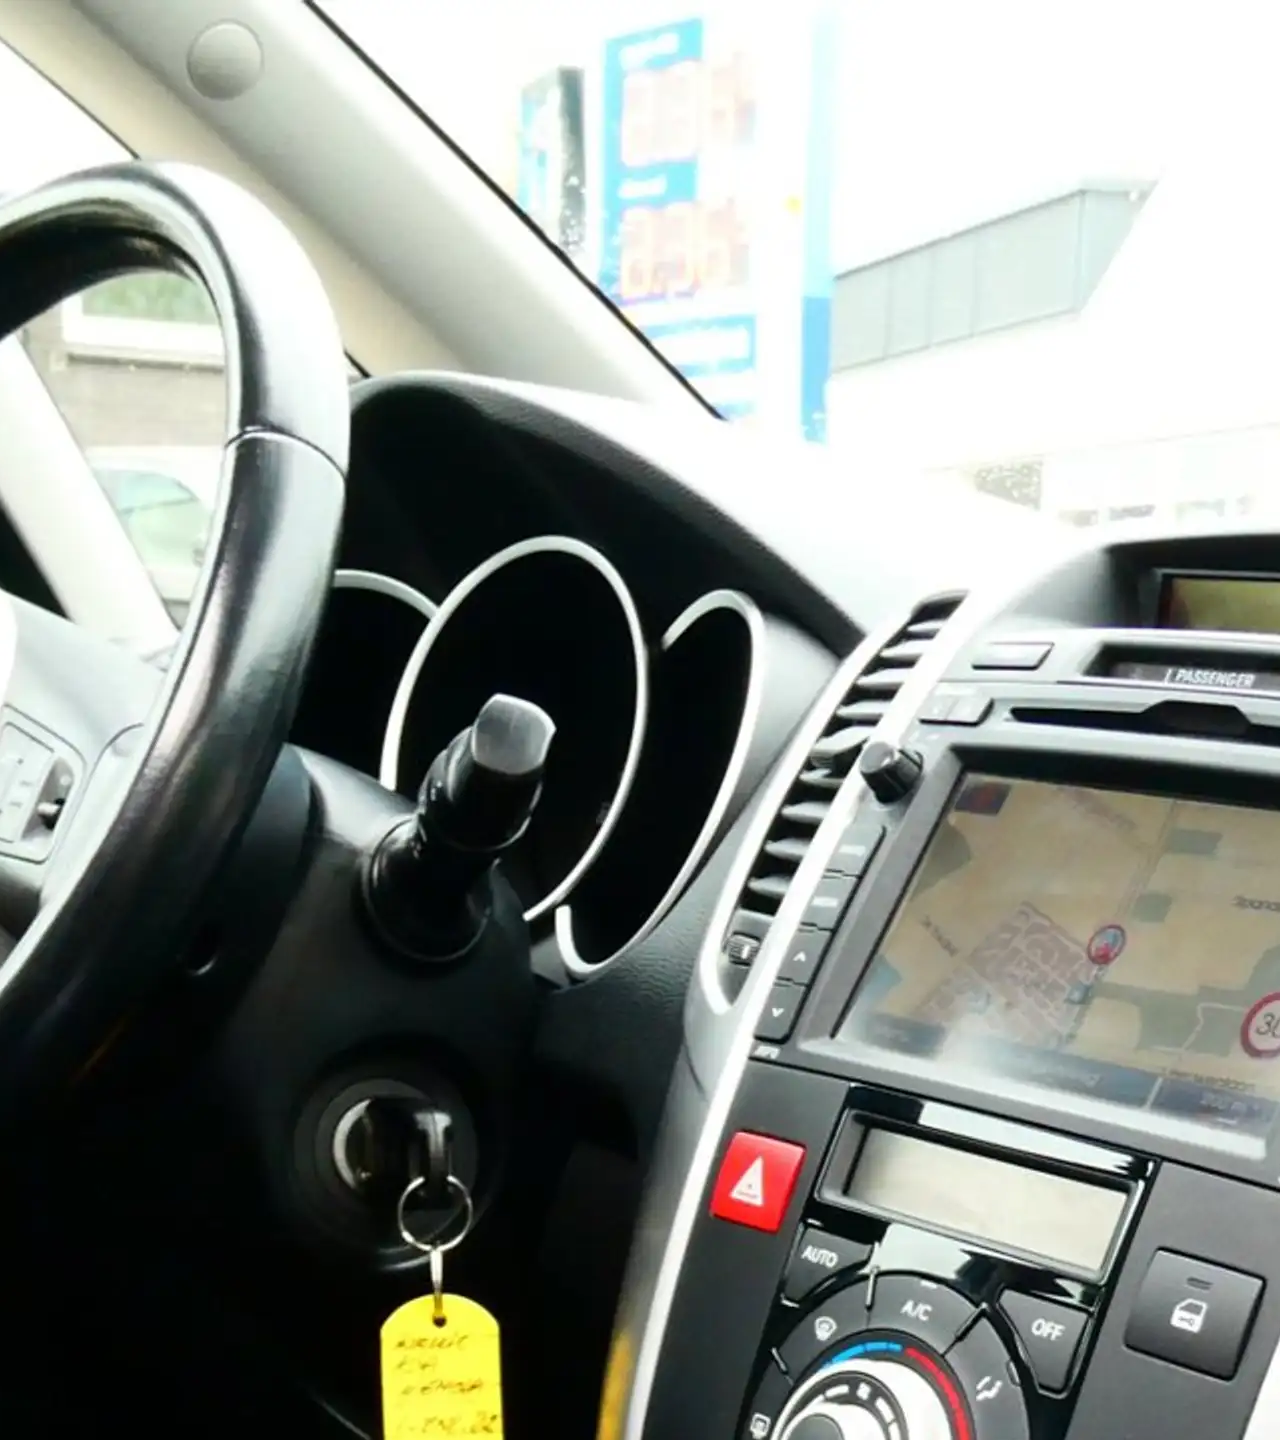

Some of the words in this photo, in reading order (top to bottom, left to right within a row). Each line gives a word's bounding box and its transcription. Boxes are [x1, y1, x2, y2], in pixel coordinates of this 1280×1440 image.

[1175, 667, 1257, 689] PASSENGER
[801, 1244, 838, 1268] AUTO
[900, 1299, 933, 1322] A/C
[1030, 1317, 1066, 1341] OFF
